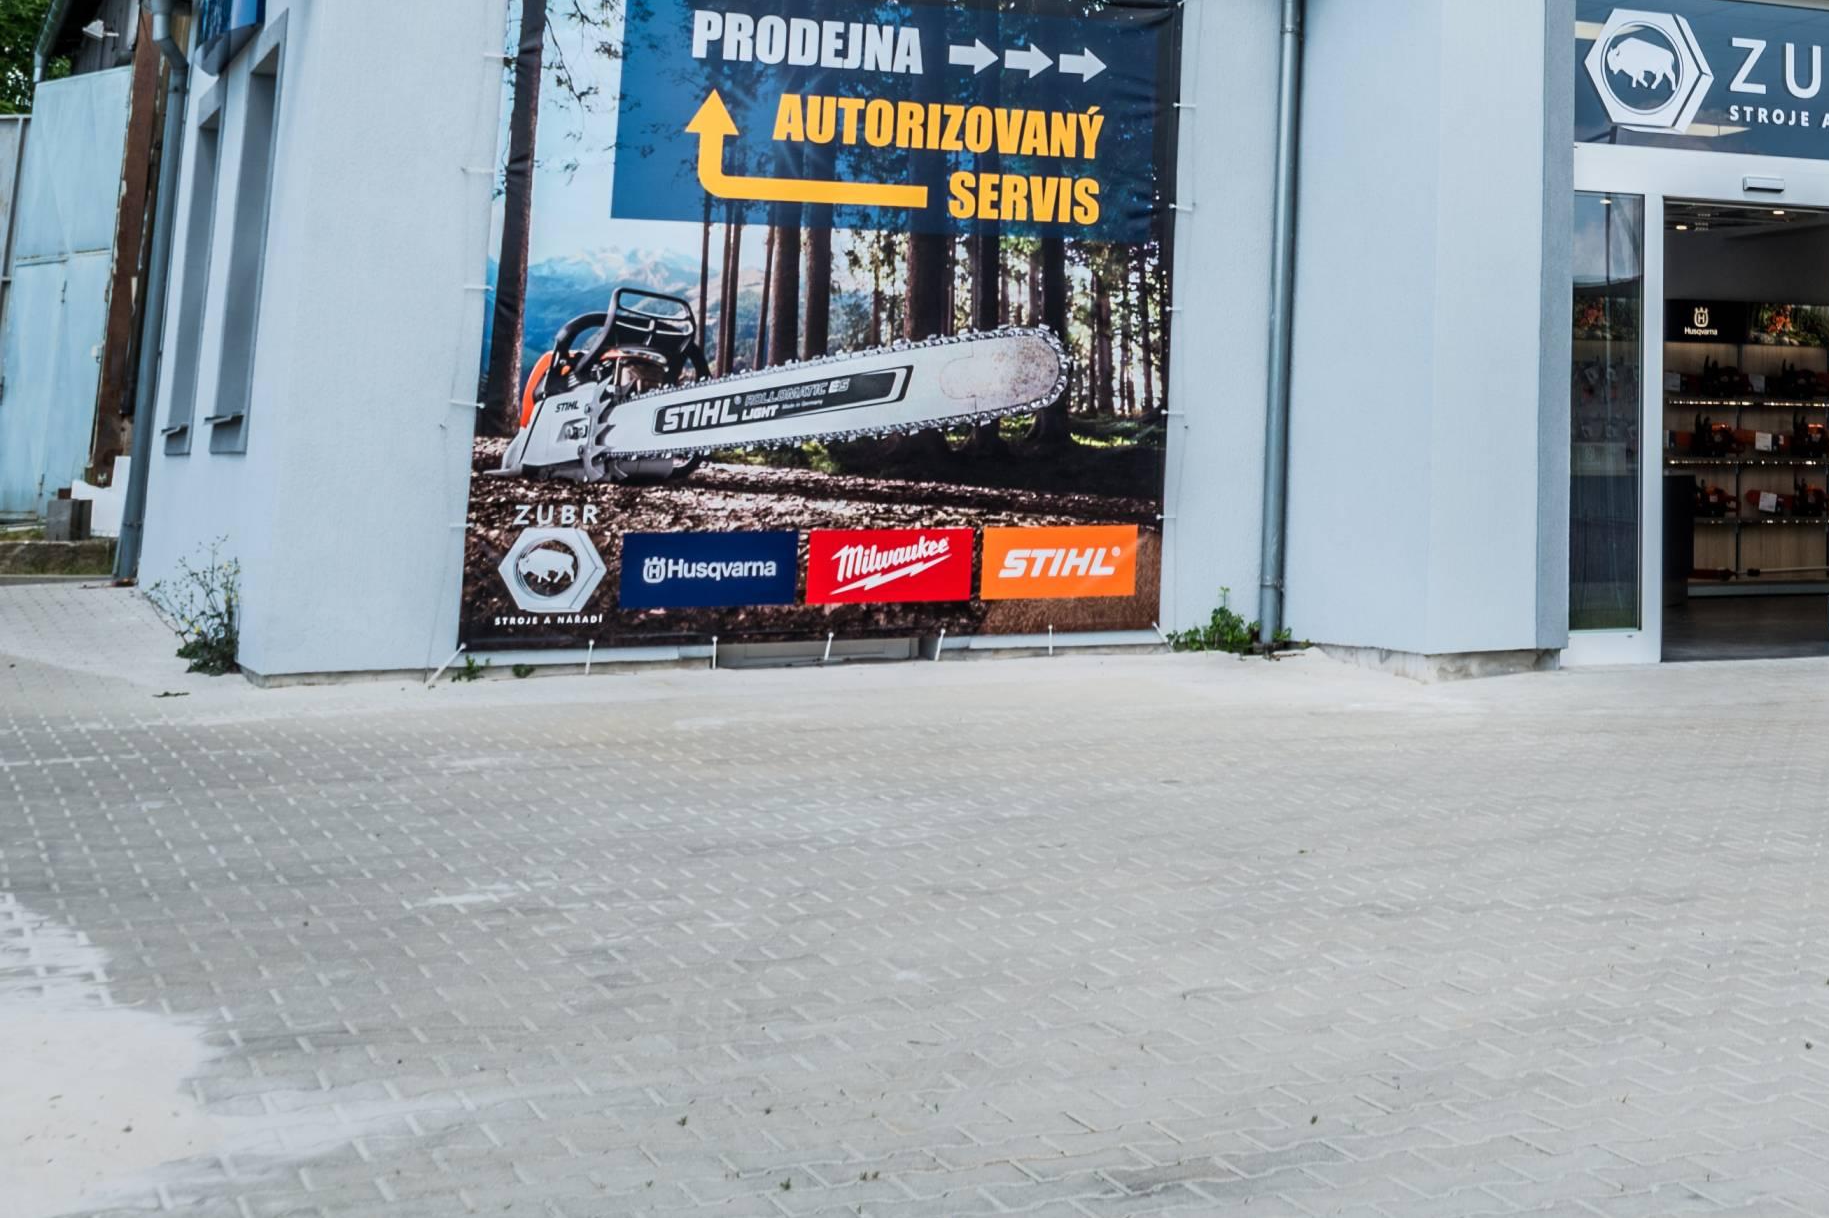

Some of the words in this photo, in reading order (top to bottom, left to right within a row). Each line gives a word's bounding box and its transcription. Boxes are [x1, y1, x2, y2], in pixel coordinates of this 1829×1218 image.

[691, 9, 924, 75] PRODEJNA
[772, 93, 1105, 160] AUTORIZOVANÝ
[1729, 104, 1810, 127] STROJE
[948, 170, 1100, 226] SERVIS
[555, 400, 580, 414] STIHL
[741, 404, 780, 422] LIGHT
[513, 504, 599, 525] ZUBR
[667, 558, 777, 582] Husqvarna
[831, 534, 950, 583] Milwaukee
[494, 616, 538, 626] STROJE
[543, 615, 552, 625] A
